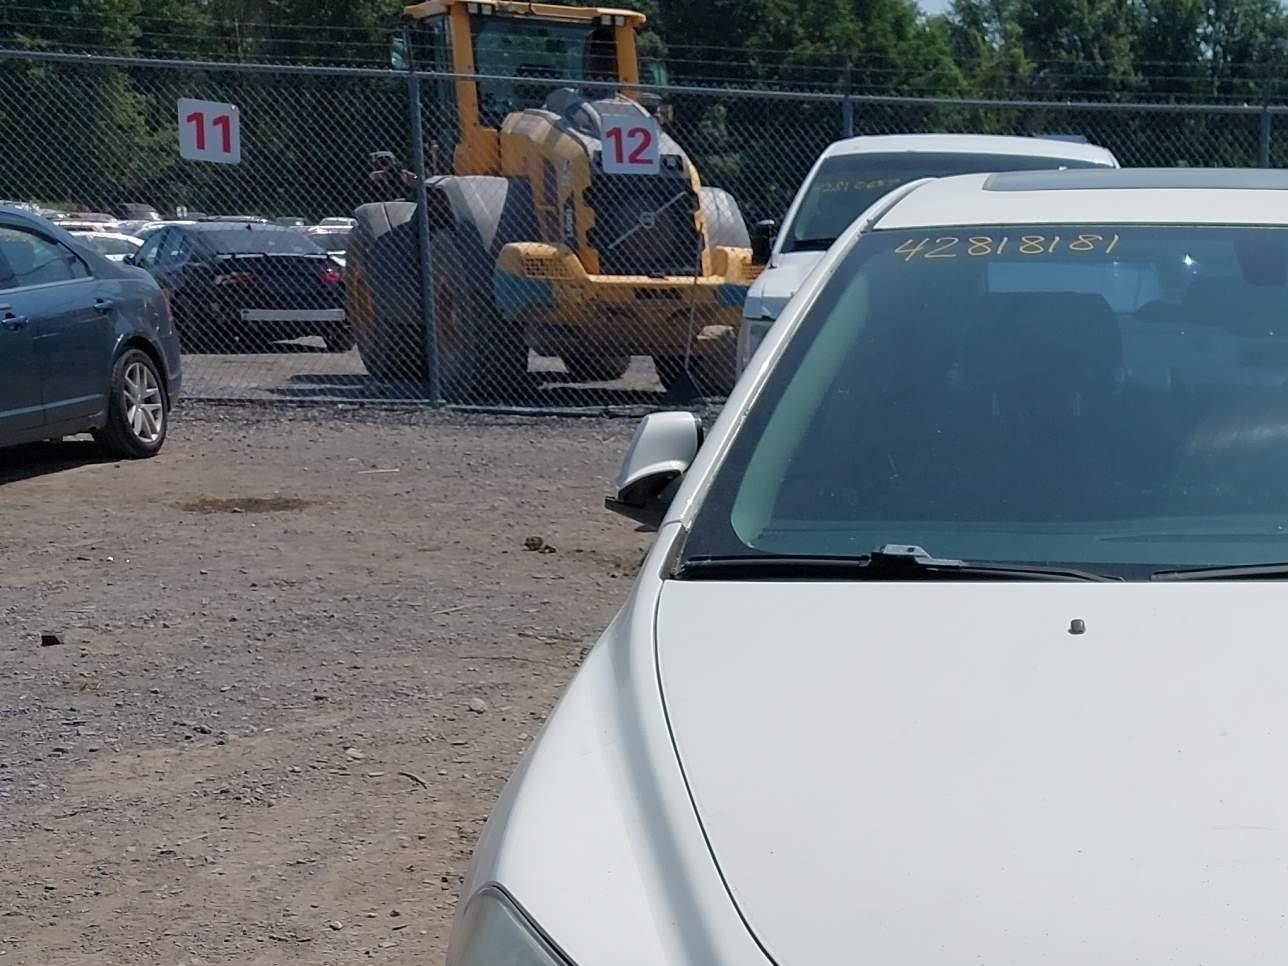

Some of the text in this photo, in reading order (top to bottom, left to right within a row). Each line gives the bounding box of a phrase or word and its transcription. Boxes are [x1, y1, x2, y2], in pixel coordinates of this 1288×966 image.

[186, 111, 232, 153] 11
[606, 127, 654, 165] 12
[894, 234, 1120, 262] 42818181
